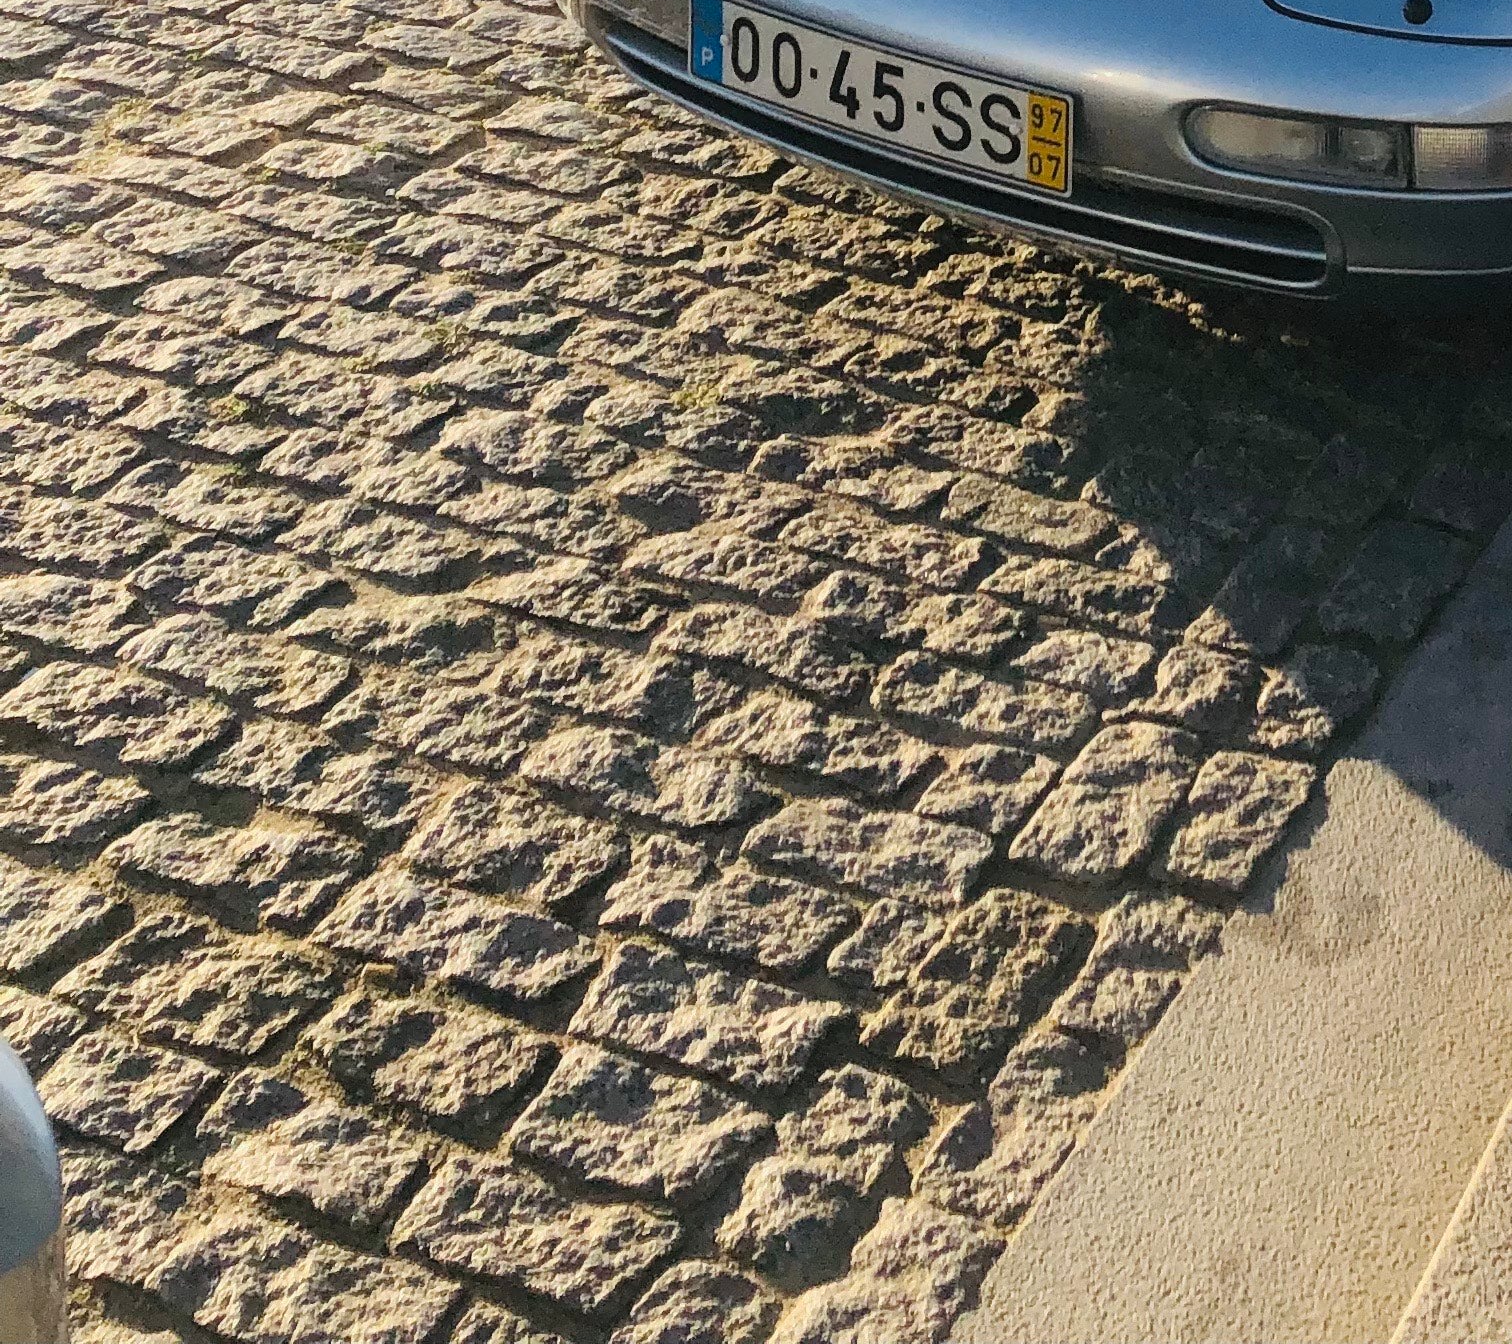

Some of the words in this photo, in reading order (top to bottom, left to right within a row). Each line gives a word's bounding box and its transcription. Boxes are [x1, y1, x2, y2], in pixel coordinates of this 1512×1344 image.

[701, 46, 714, 67] P
[1030, 103, 1064, 134] 97
[1028, 151, 1062, 182] 07
